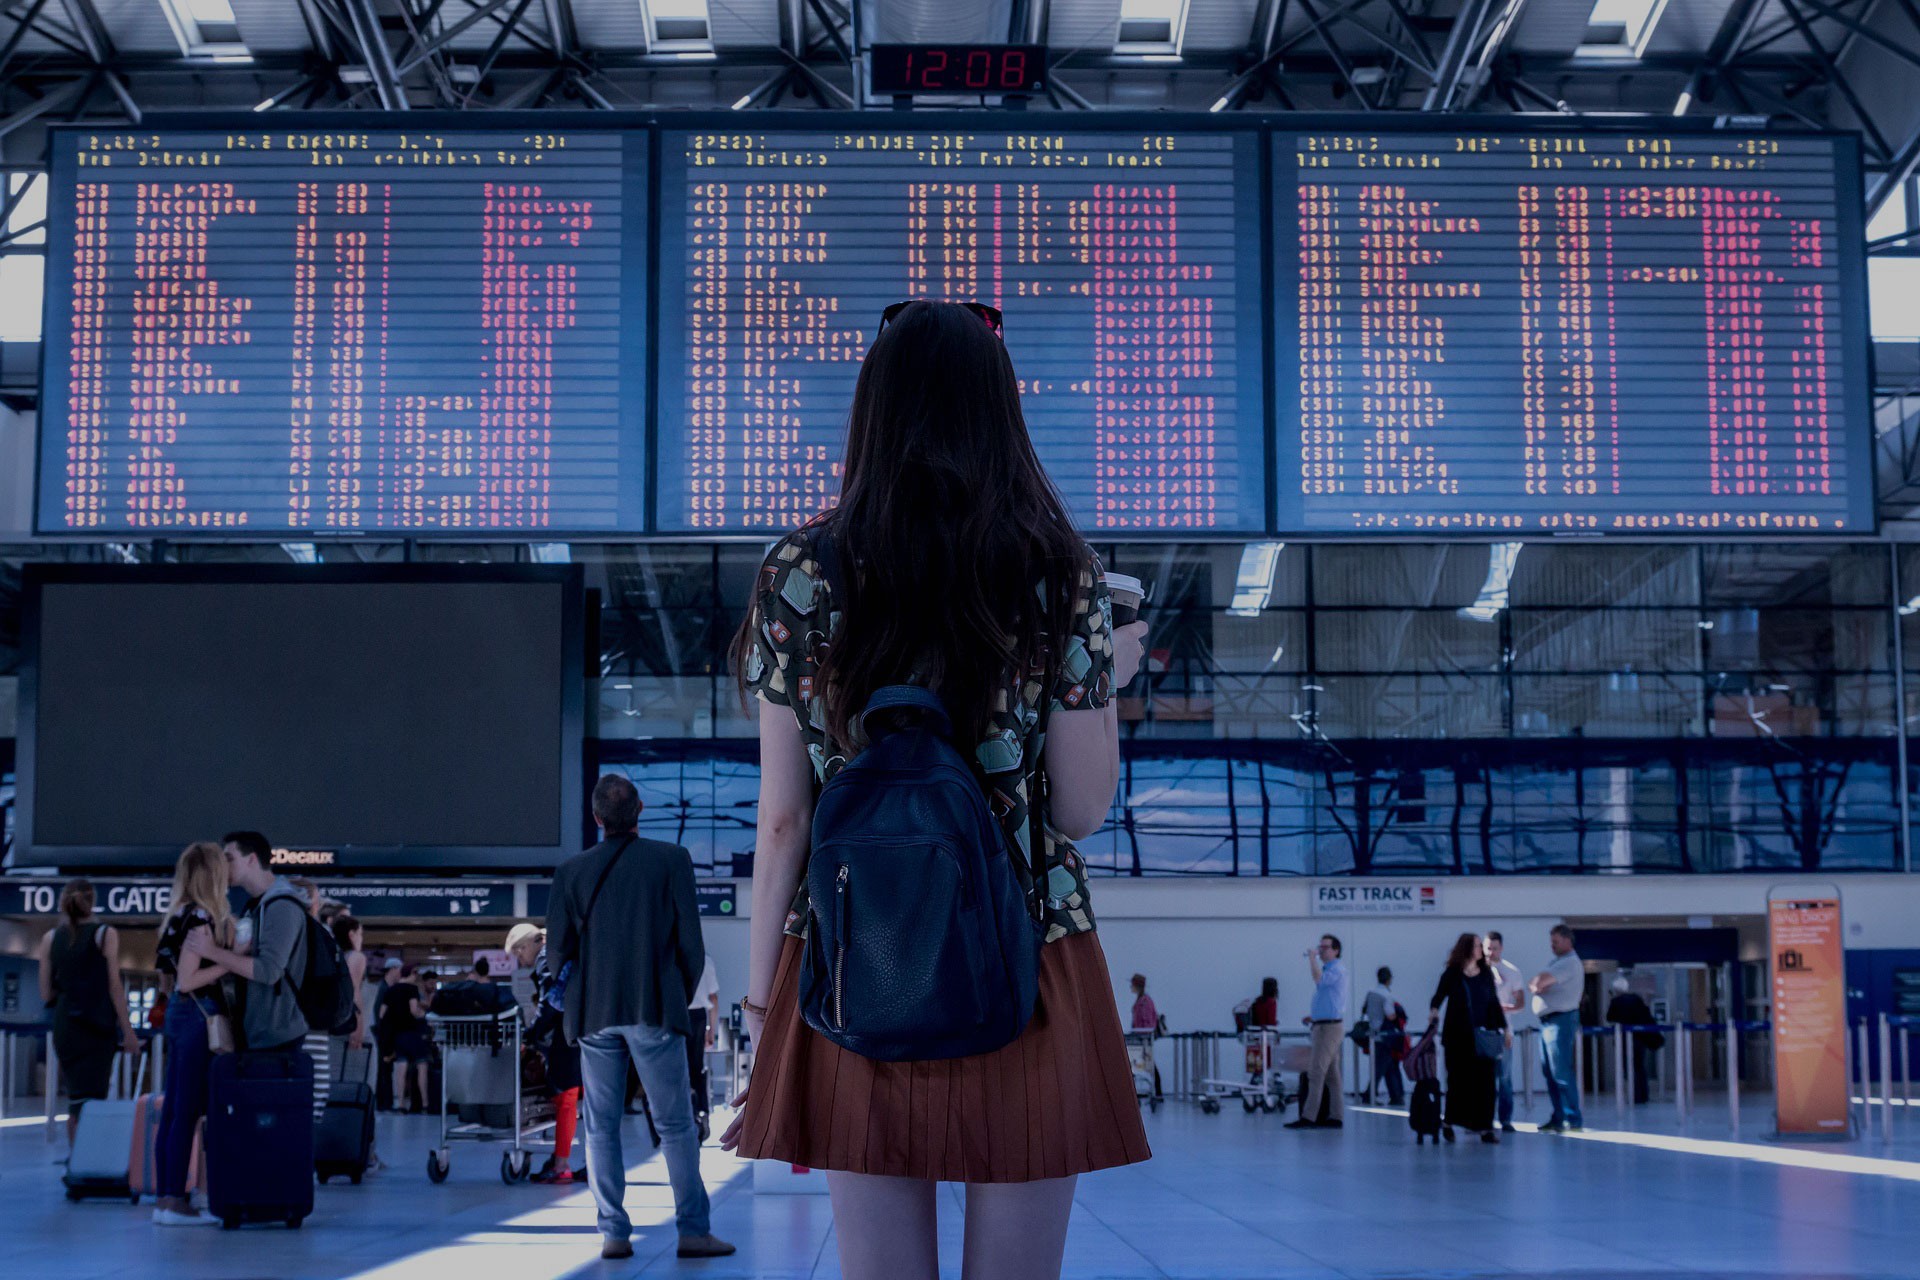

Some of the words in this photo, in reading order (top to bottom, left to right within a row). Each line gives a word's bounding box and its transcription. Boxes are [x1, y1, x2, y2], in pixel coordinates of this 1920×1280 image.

[904, 50, 1028, 88] 12:08
[19, 885, 55, 913] TO
[108, 886, 172, 913] GATE
[327, 887, 348, 897] YOUR
[349, 887, 387, 897] PASSPORT
[388, 887, 404, 897] AND
[405, 887, 444, 897] BOARDING
[445, 887, 463, 897] PASS
[464, 887, 489, 897] READY
[1319, 887, 1356, 900] FAST
[1362, 887, 1412, 900] TRACK
